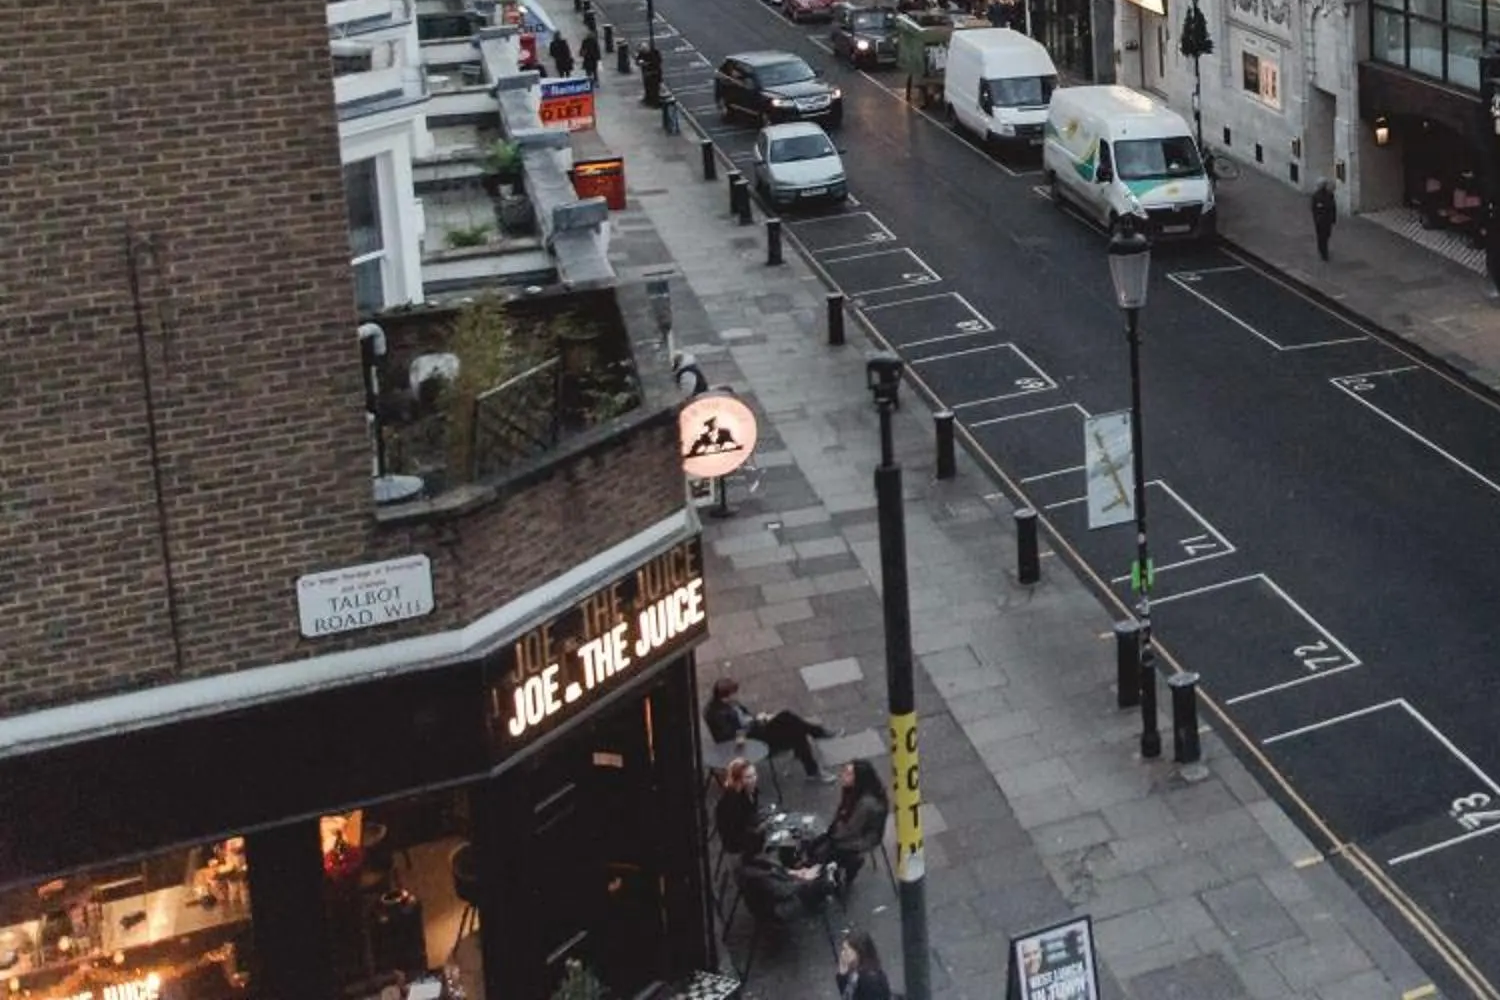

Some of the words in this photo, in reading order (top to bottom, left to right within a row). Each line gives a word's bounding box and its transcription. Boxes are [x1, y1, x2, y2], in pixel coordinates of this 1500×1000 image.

[328, 585, 402, 613] TALBOT
[508, 663, 562, 737] JOE
[577, 621, 631, 690] THE
[635, 577, 704, 657] JUICE
[1292, 639, 1342, 671] 72
